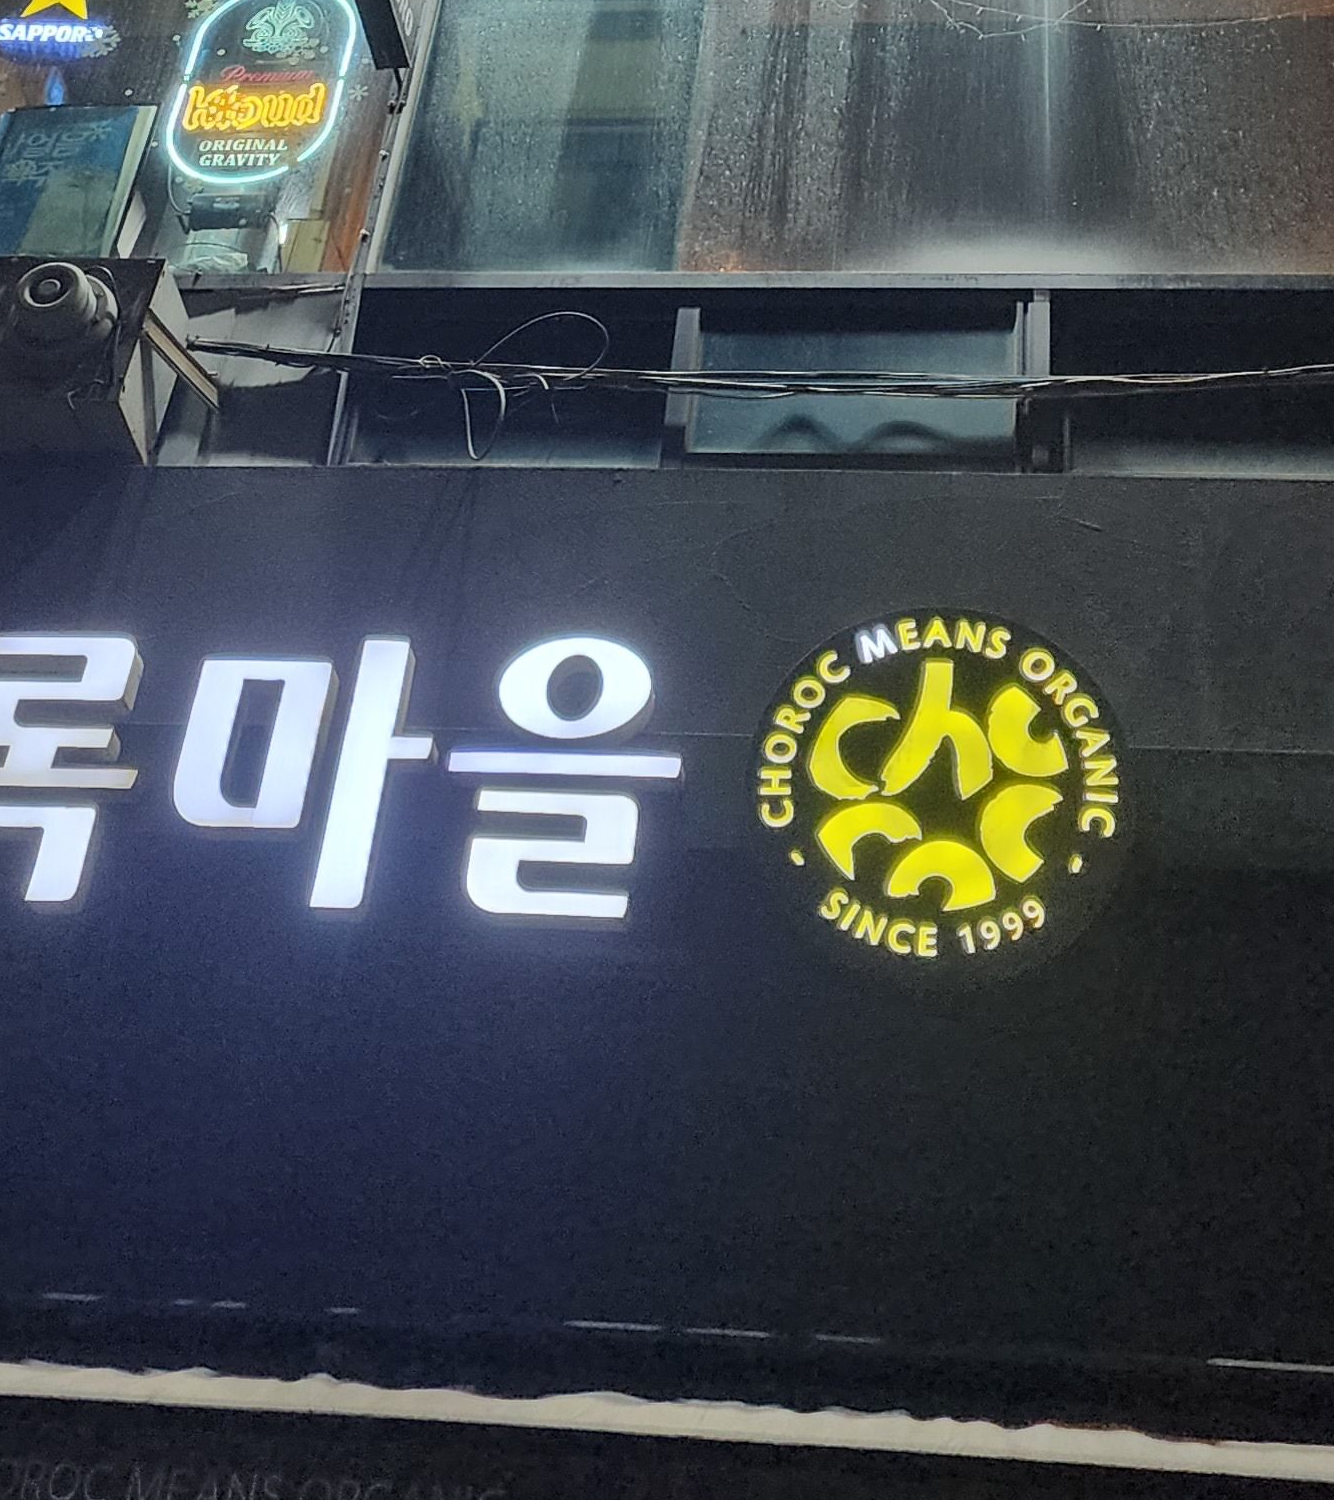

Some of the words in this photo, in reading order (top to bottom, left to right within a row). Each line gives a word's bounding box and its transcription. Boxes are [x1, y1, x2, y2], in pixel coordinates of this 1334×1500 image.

[198, 137, 289, 152] ORIGINAL
[198, 152, 282, 168] GRAVITY
[757, 649, 852, 829] CHOROC
[853, 615, 1012, 665] MEANS
[1018, 646, 1120, 839] ORGANIC
[818, 887, 939, 958] SINCE
[956, 895, 1047, 954] 1999
